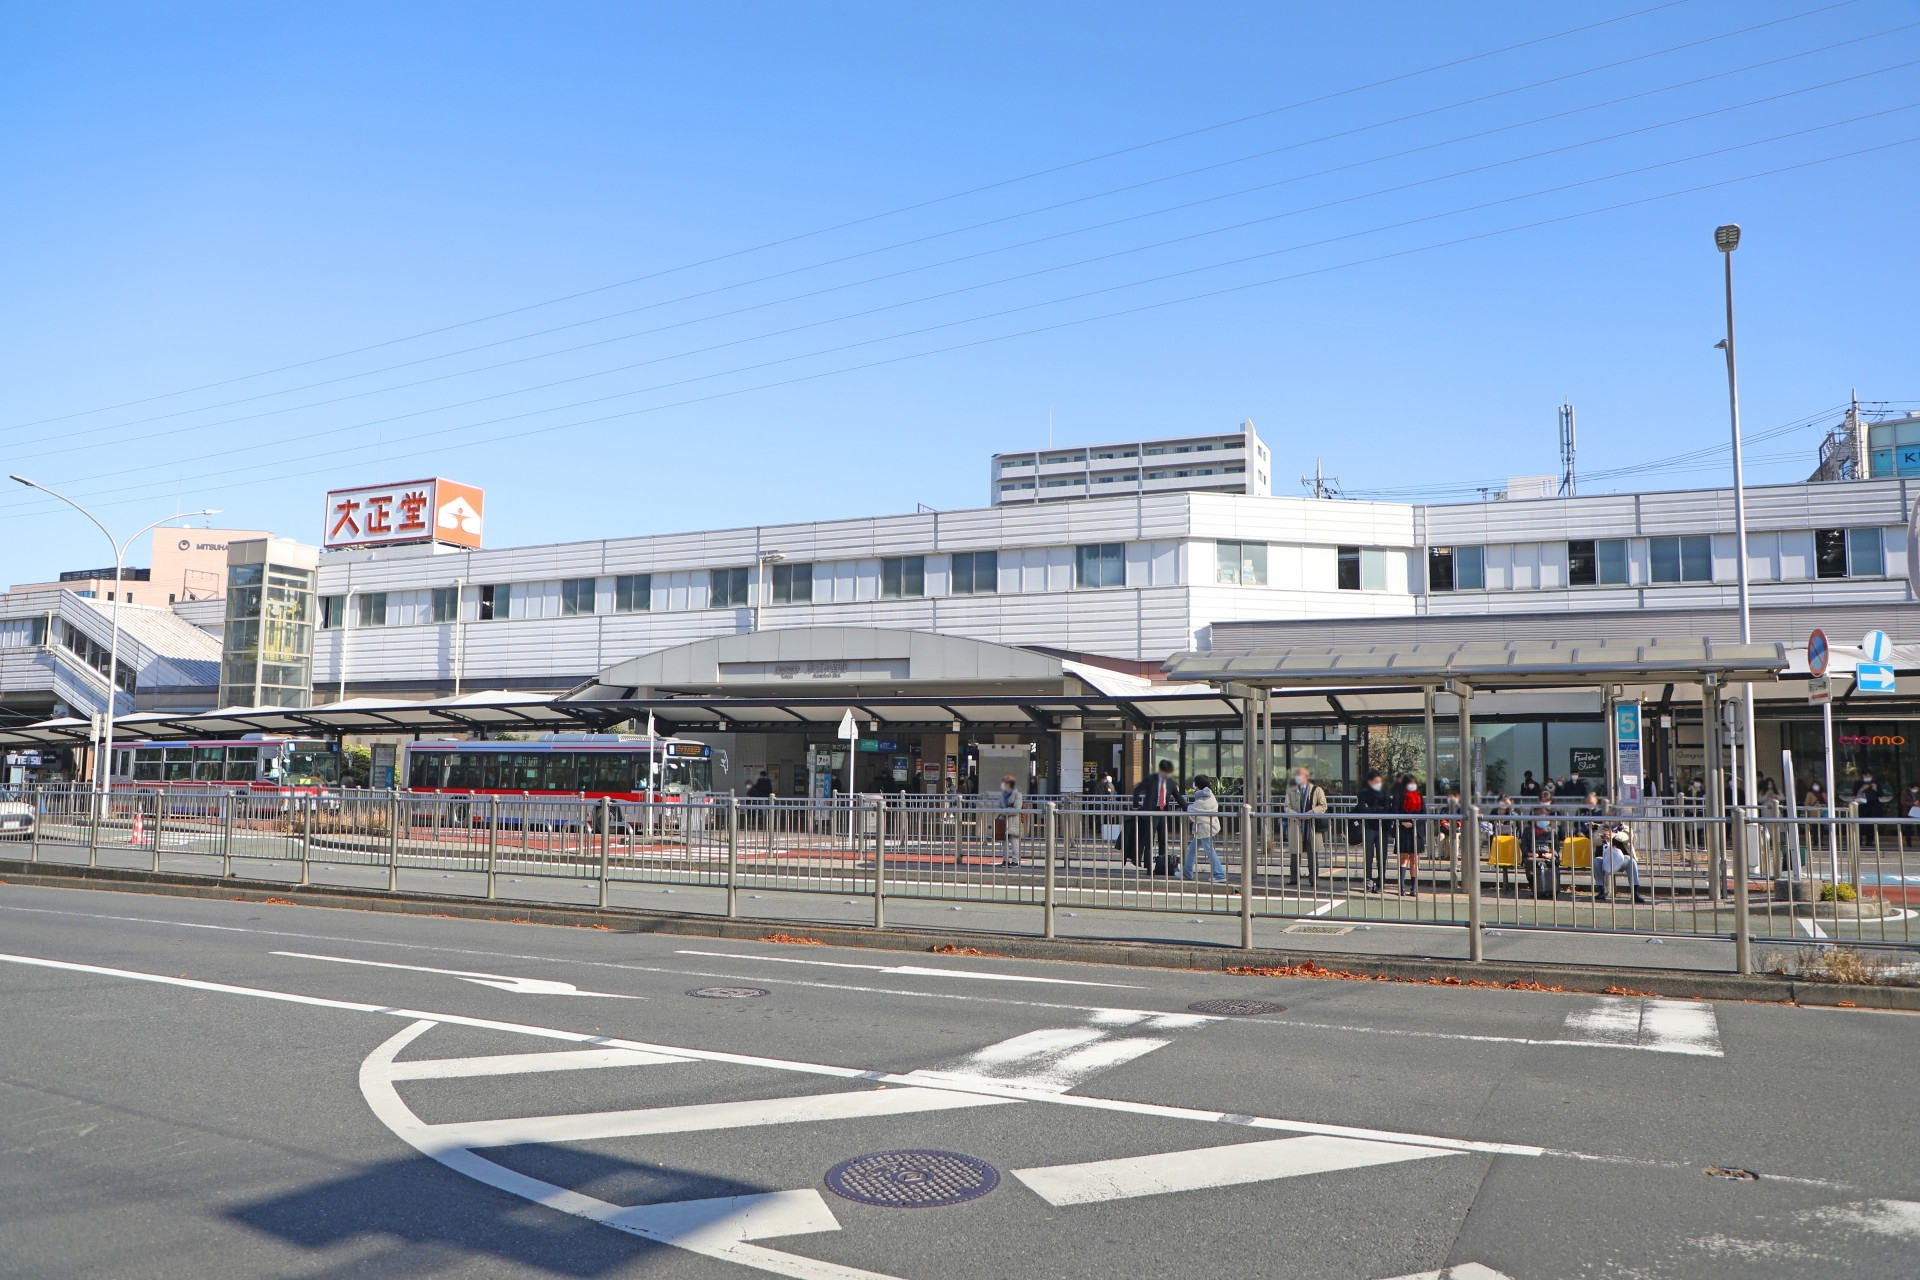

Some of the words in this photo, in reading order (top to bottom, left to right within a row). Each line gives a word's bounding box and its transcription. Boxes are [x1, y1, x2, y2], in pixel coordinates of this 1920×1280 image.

[331, 491, 427, 537] 大正堂
[1620, 713, 1636, 733] 5
